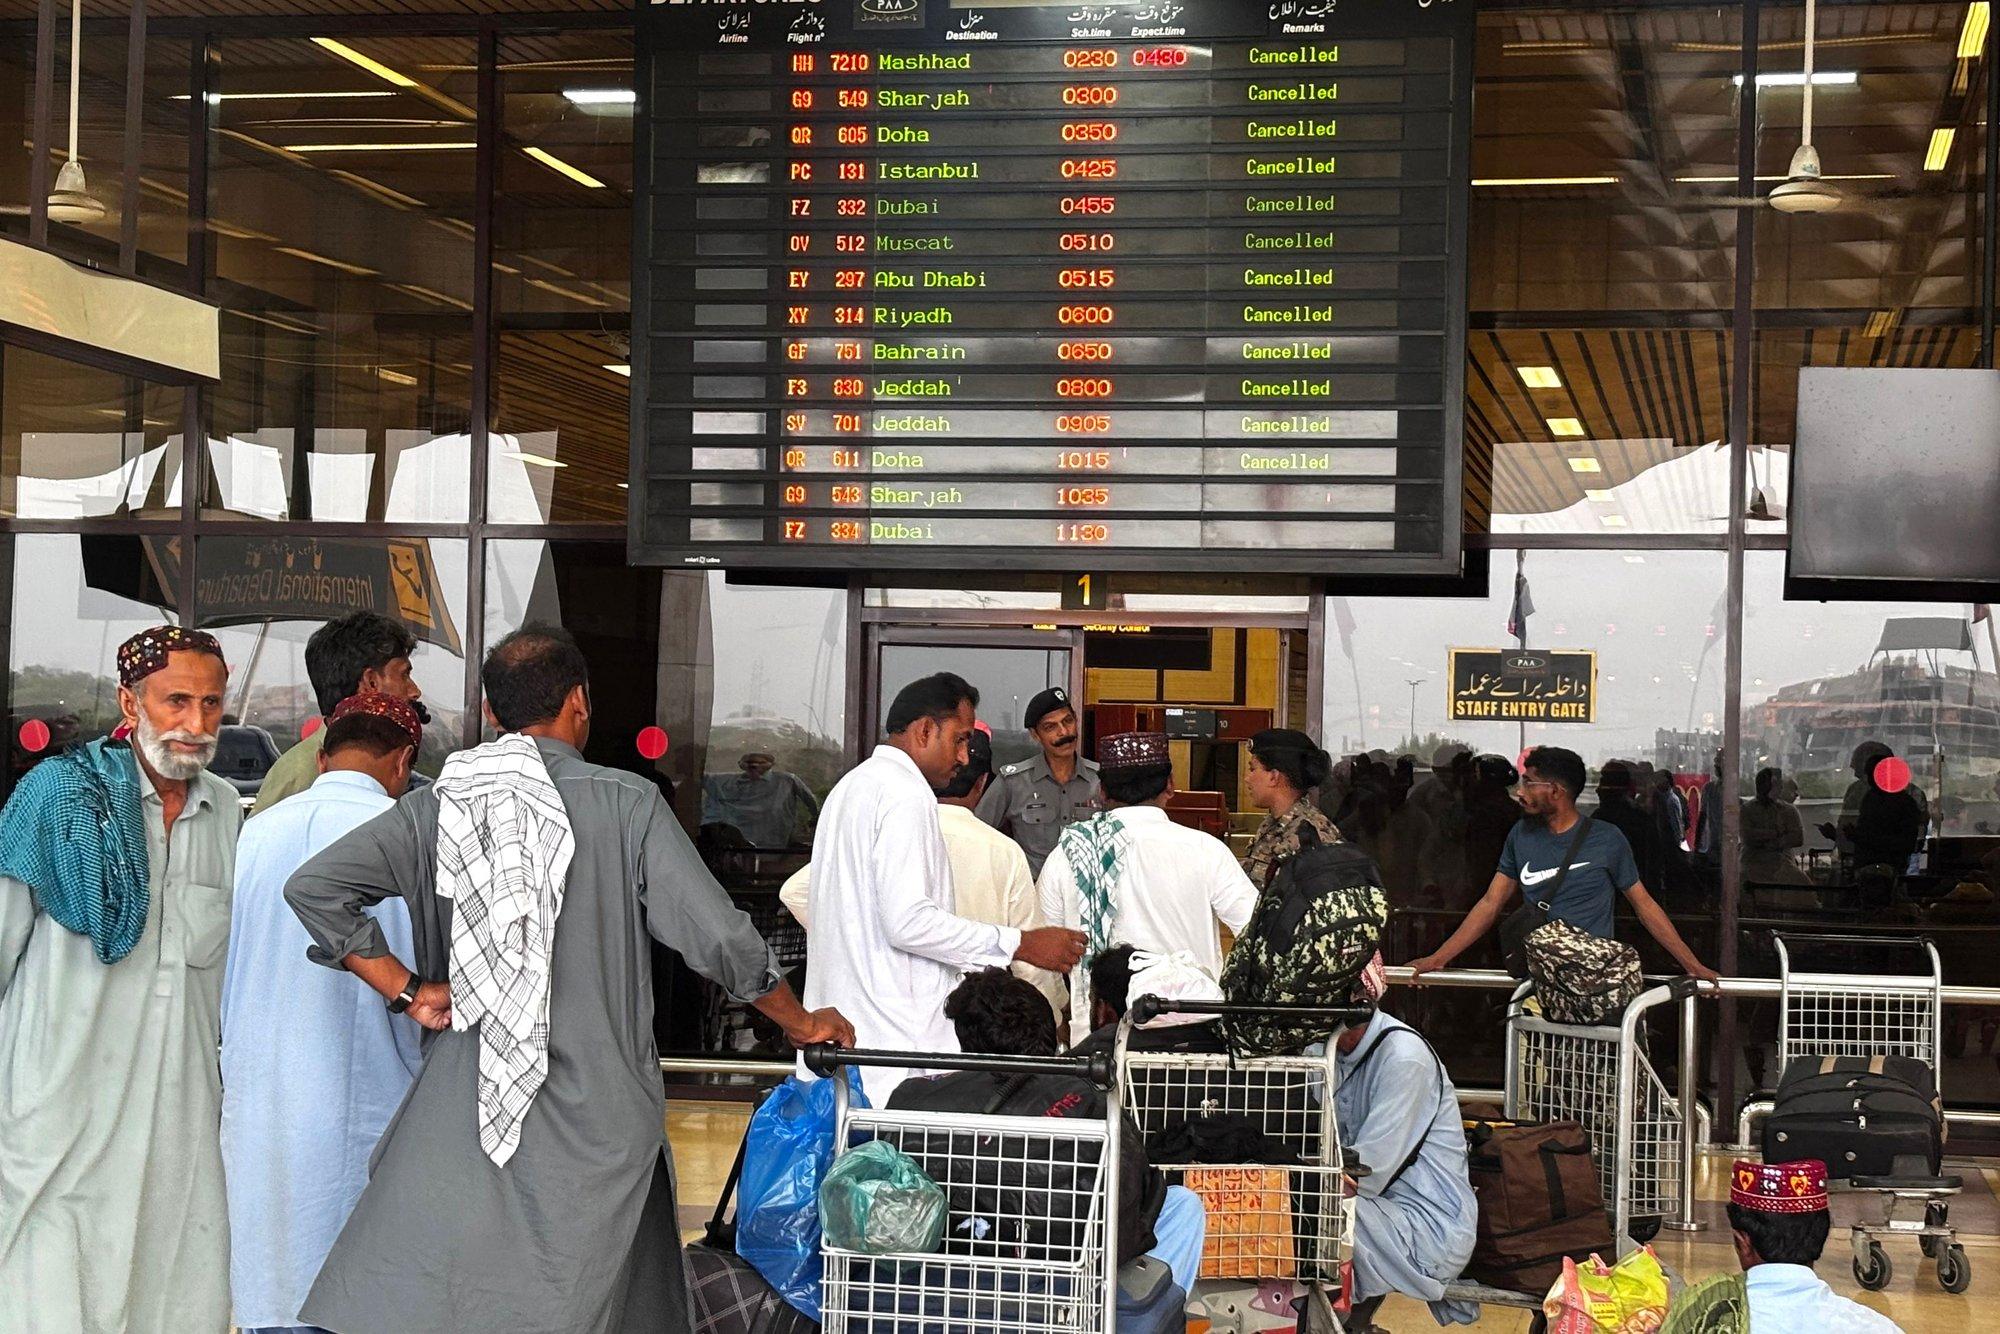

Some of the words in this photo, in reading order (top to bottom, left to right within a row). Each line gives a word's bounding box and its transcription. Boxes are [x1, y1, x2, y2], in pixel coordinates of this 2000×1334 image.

[960, 9, 984, 29] منزل
[1067, 8, 1092, 22] وقت
[1134, 7, 1159, 20] وقت
[946, 31, 998, 41] Destination
[1283, 23, 1325, 34] Remarks
[719, 34, 749, 43] Airline
[787, 33, 813, 44] Flight
[793, 55, 814, 71] HH
[830, 55, 868, 71] 7210
[879, 54, 970, 70] Mashhad
[1064, 51, 1117, 67] 0230
[1133, 49, 1187, 66] 0430
[1249, 47, 1338, 64] Cancelled
[792, 91, 811, 107] G9
[839, 91, 868, 107] 549
[878, 90, 970, 110] Sharjah
[1063, 88, 1117, 104] 0300
[1248, 84, 1337, 101] Cancelled
[792, 128, 811, 144] QR
[839, 128, 867, 143] 605
[878, 127, 929, 142] Doha
[1062, 124, 1116, 140] 0350
[1248, 121, 1336, 138] Cancelled
[792, 164, 811, 180] PC
[839, 164, 865, 179] 131
[879, 163, 979, 179] Istanbul
[1062, 161, 1115, 177] 0425
[1247, 158, 1335, 175] Cancelled
[792, 200, 810, 216] FZ
[837, 200, 865, 216] 332
[877, 199, 939, 215] Dubai
[1061, 197, 1114, 213] 0455
[1246, 196, 1334, 212] Cancelled
[791, 236, 809, 251] OV
[836, 236, 865, 252] 512
[877, 236, 953, 250] Muscat
[1060, 234, 1114, 250] 0510
[1245, 233, 1333, 249] Cancelled
[790, 272, 809, 288] EY
[836, 272, 865, 288] 297
[875, 272, 914, 288] Abu
[924, 272, 986, 287] Dhabi
[1059, 271, 1114, 287] 0515
[1244, 271, 1332, 286] Cancelled
[788, 308, 808, 323] XY
[835, 308, 864, 323] 314
[875, 307, 952, 327] Riyadh
[1058, 307, 1113, 323] 0600
[1244, 306, 1331, 323] Cancelled
[788, 344, 807, 360] GF
[836, 344, 862, 359] 751
[874, 344, 965, 359] Bahrain
[1058, 344, 1112, 359] 0650
[1243, 343, 1330, 360] Cancelled
[788, 380, 807, 395] F3
[833, 380, 863, 395] 830
[873, 380, 950, 396] Jeddah
[1057, 380, 1111, 396] 0800
[1242, 380, 1330, 396] Cancelled
[787, 416, 806, 431] SV
[833, 416, 860, 431] 701
[873, 416, 950, 431] Jeddah
[1057, 416, 1110, 432] 0905
[1241, 417, 1329, 433] Cancelled
[833, 452, 859, 467] 611
[873, 452, 923, 467] Doha
[1058, 453, 1109, 468] 1015
[1241, 454, 1329, 470] Cancelled
[786, 488, 805, 502] G9
[871, 487, 962, 507] Sharjah
[1057, 489, 1108, 505] 1035
[785, 523, 805, 538] FZ
[831, 523, 860, 539] 334
[871, 523, 933, 539] Dubai
[1057, 525, 1108, 541] 1130
[1078, 574, 1091, 606] 1
[1517, 659, 1535, 667] PAA
[1457, 673, 1490, 697] عملہ
[1490, 676, 1542, 699] برائے
[1544, 674, 1587, 698] داخلہ
[1456, 700, 1498, 716] STAFF
[1501, 702, 1547, 717] ENTRY
[1551, 703, 1586, 718] GATE
